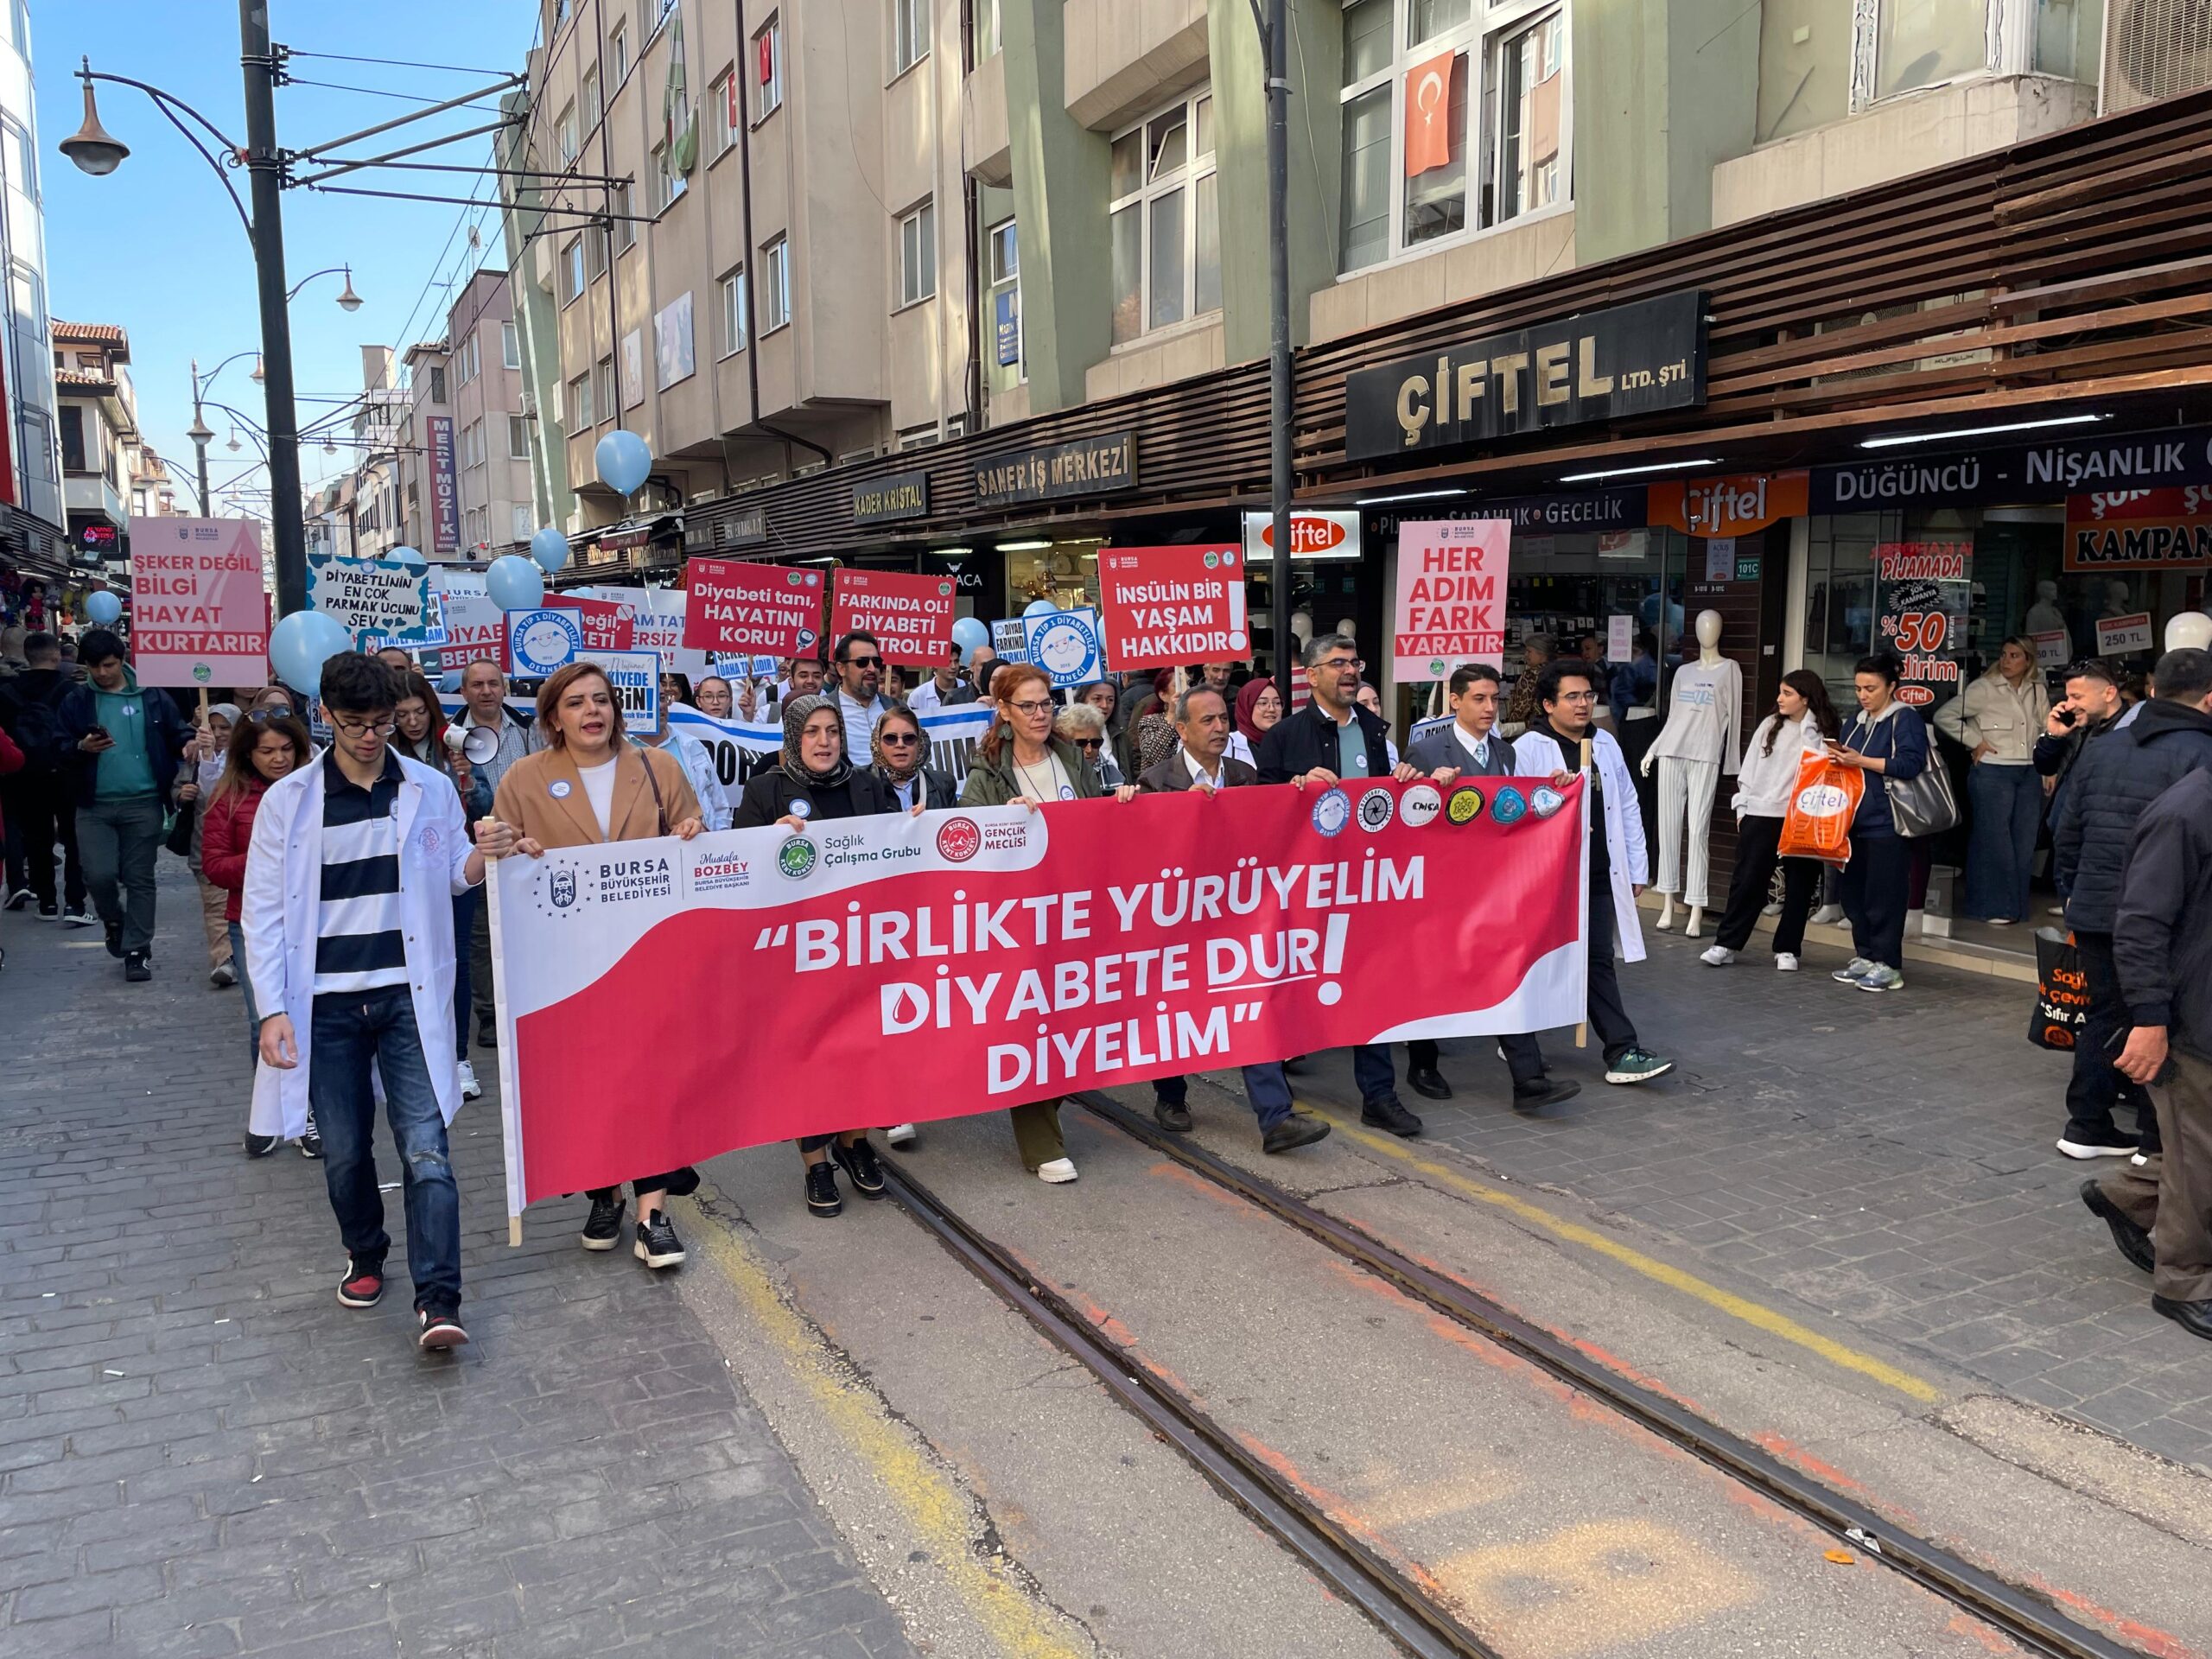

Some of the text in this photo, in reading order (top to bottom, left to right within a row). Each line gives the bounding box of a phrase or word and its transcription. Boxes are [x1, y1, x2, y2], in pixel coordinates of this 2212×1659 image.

[1396, 335, 1686, 446] ÇİFTEL LTD. ŞTİ
[433, 420, 450, 469] MERT
[977, 438, 1128, 496] SANER İŞ MERKEZİ
[1835, 457, 1980, 502] DÜĞÜNCÜ
[2026, 442, 2185, 487] NİŞANLIK
[855, 484, 922, 516] KADER KRİSTAL
[1545, 495, 1623, 524] GECELİK
[1681, 478, 1767, 534] Çiftel
[1289, 521, 1333, 553] iftel
[133, 553, 260, 574] ŞEKER DEĞİL,
[1422, 546, 1484, 573] HER
[1738, 563, 1758, 574] 101C
[1880, 553, 1964, 581] PİJAMADA
[136, 573, 198, 596] BİLGİ
[326, 569, 413, 589] DİYABETLİNİN
[1408, 575, 1495, 603] ADIM
[1910, 584, 1924, 594] ŞOK
[344, 585, 391, 601] EN ÇOK
[694, 582, 816, 609] Diyabeti tanı,
[1116, 578, 1223, 604] İNSÜLİN BİR
[1900, 588, 1937, 607] KAMPANYA
[325, 597, 420, 615] PARMAK UCUNU
[838, 593, 950, 614] FARKINDA OL!
[137, 605, 224, 624] HAYAT
[347, 613, 379, 628] SEV
[581, 613, 621, 632] eğil,
[704, 603, 805, 628] HAYATINI
[850, 611, 936, 634] DİYABETİ
[1131, 605, 1214, 635] YAŞAM
[1408, 605, 1493, 632] FARK
[137, 632, 263, 652] KURTARIR
[514, 628, 524, 653] BURSA
[522, 616, 534, 628] TİP
[719, 626, 785, 647] KORU!
[1032, 634, 1042, 663] BURSA
[1038, 623, 1049, 634] TİP
[1056, 616, 1095, 655] DİYABETLİLER
[1880, 611, 1947, 652] %50
[2105, 633, 2126, 647] 250
[836, 633, 949, 657] TROL ET
[1398, 634, 1499, 656] YARATIR
[720, 662, 741, 677] DAHA
[1049, 666, 1087, 683] DERNEĞİ
[1900, 653, 1958, 682] dirim
[1900, 689, 1928, 703] Çiftel
[948, 822, 969, 832] BURSA
[984, 826, 1027, 838] GENÇLİK
[785, 839, 810, 849] BURSA
[824, 834, 864, 849] Sağlık
[941, 840, 954, 855] KENT
[984, 836, 1027, 850] MECLİSİ
[699, 851, 739, 865] Mustafa
[780, 858, 792, 874] KENT
[824, 845, 921, 868] Çalışma Grubu
[600, 857, 670, 879] BURSA
[694, 861, 748, 878] BOZBEY
[601, 873, 670, 891] BÜYÜKŞEHİR
[714, 875, 749, 884] BÜYÜKŞEHİR
[724, 880, 750, 889] BAŞKANI
[1108, 847, 1425, 932] YÜRÜYELİM
[601, 886, 671, 903] BELEDİYESİ
[880, 913, 1350, 1036] DİYABETE DUR!
